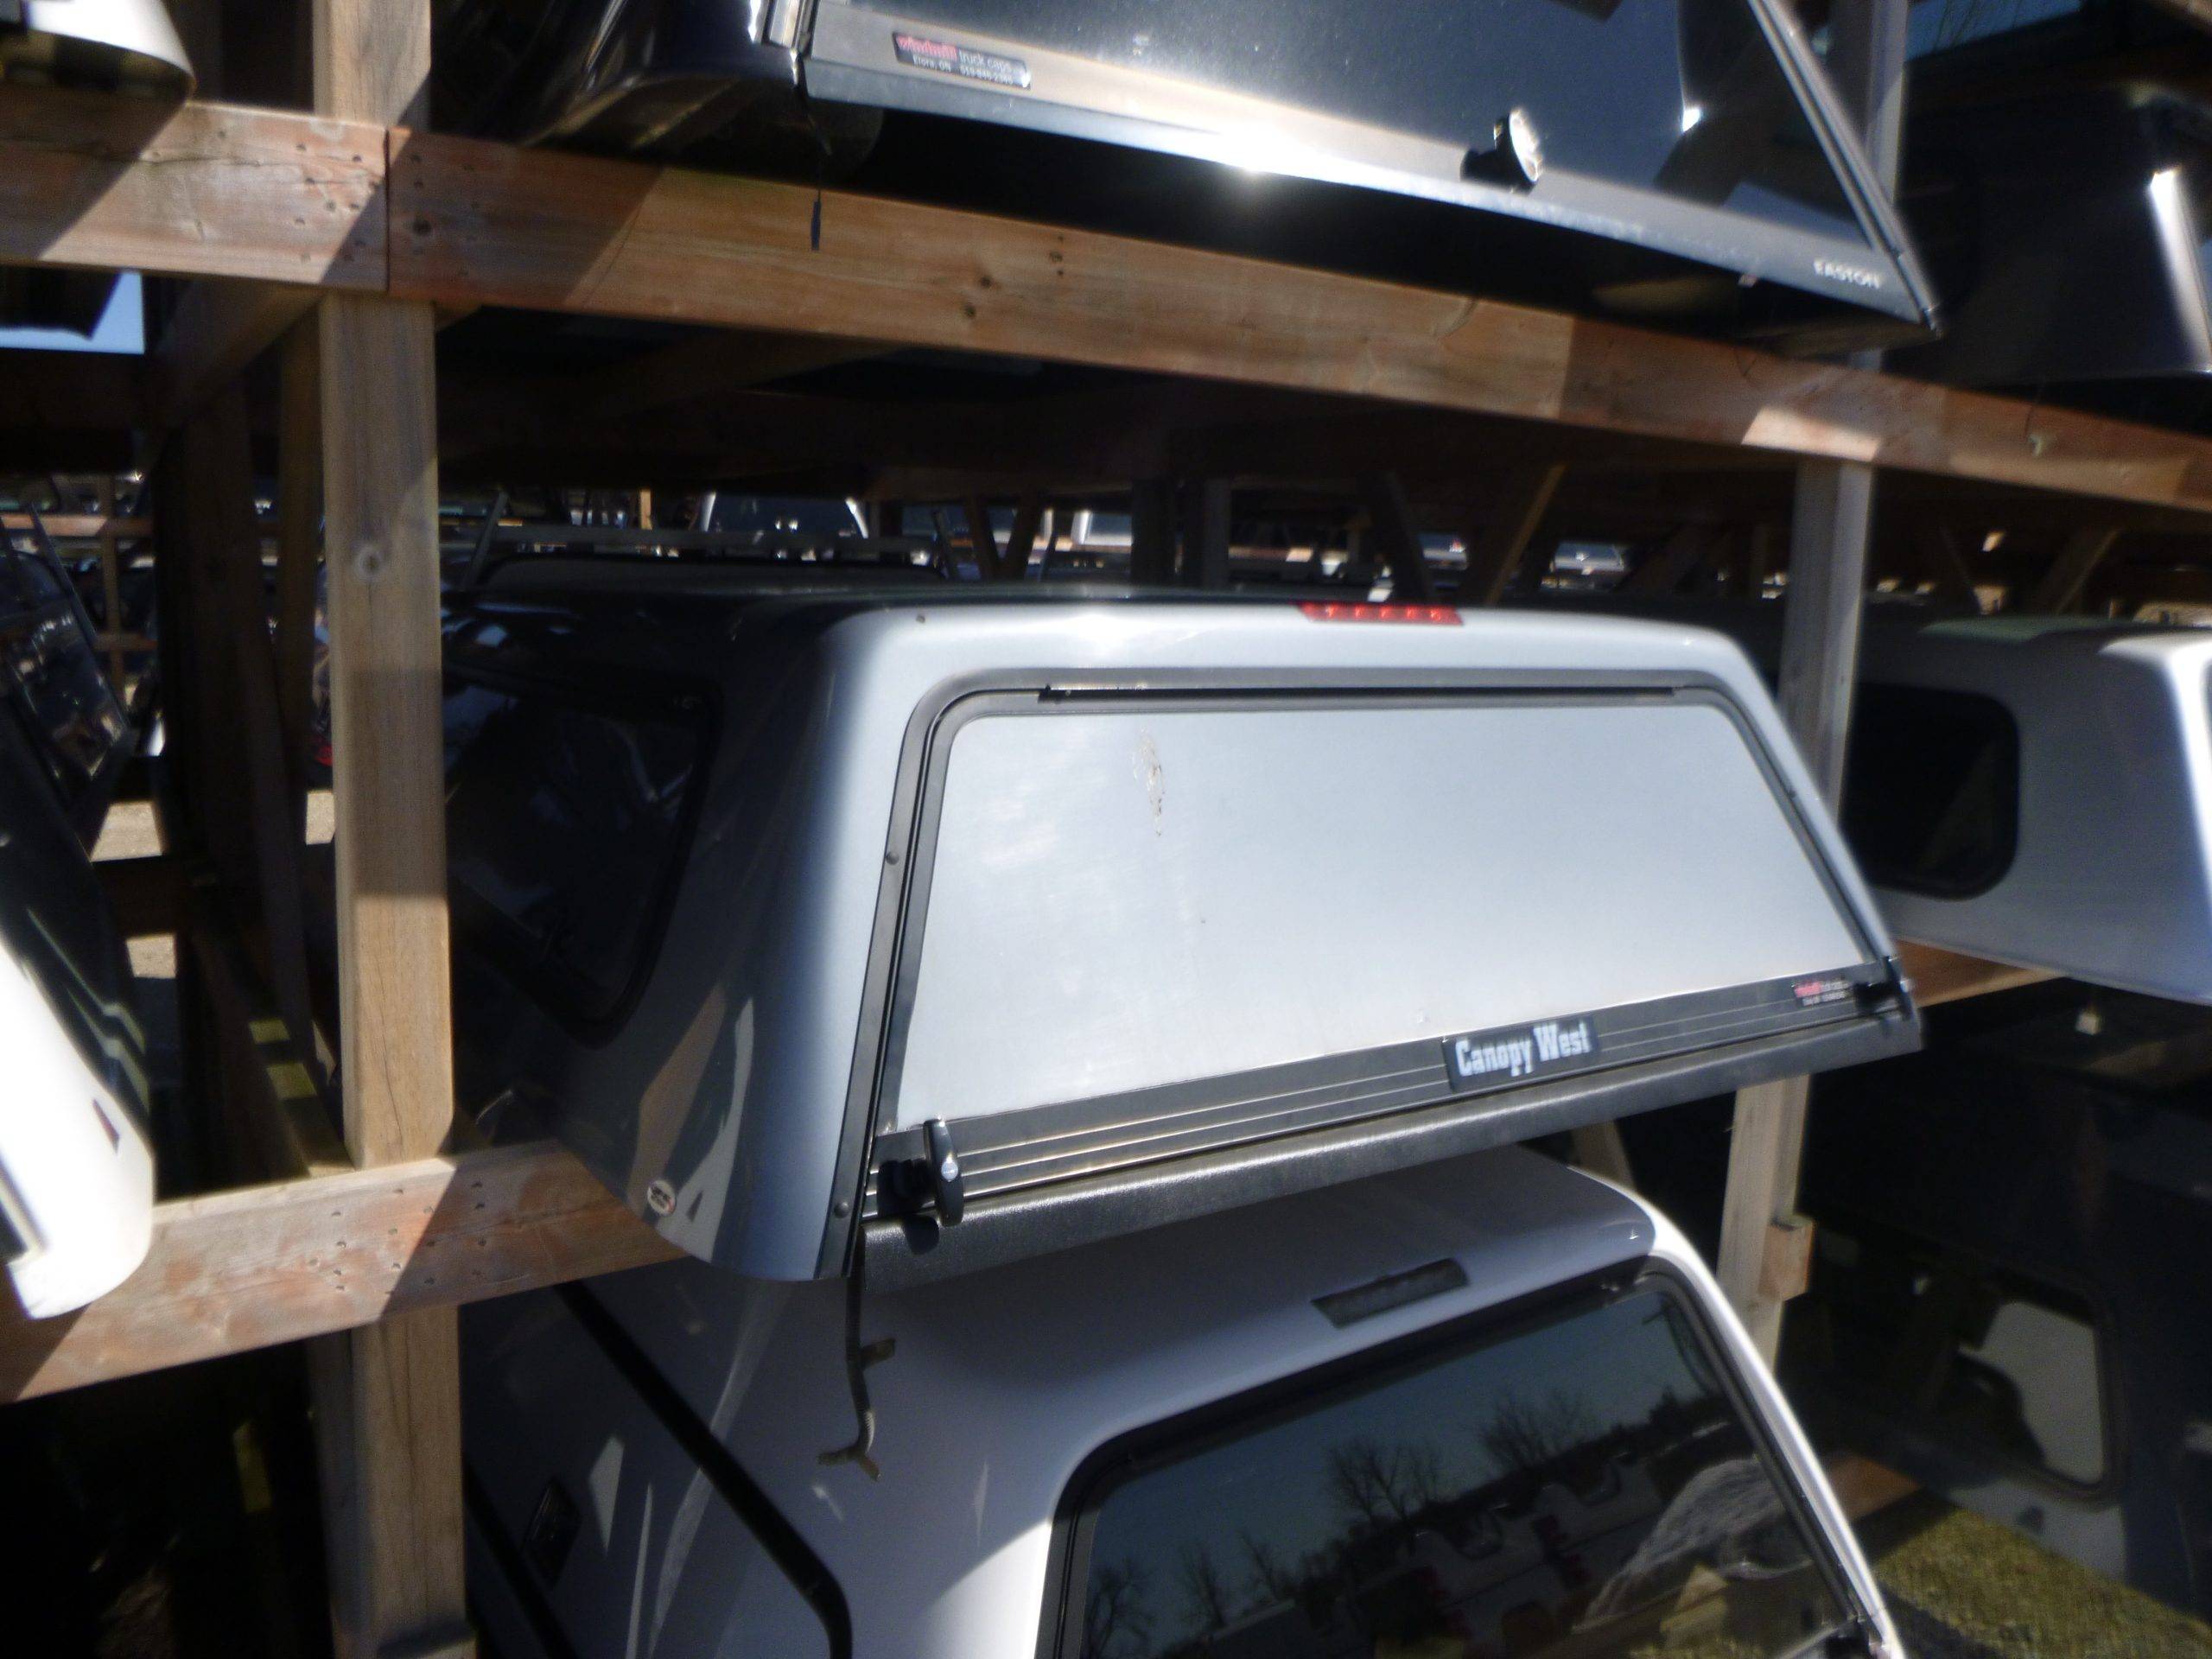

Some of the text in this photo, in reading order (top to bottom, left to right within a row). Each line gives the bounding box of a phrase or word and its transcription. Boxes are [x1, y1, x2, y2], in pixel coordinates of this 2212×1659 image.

[958, 48, 984, 66] truck
[1813, 261, 1880, 289] EASTON
[1455, 1020, 1592, 1077] Canopy West
